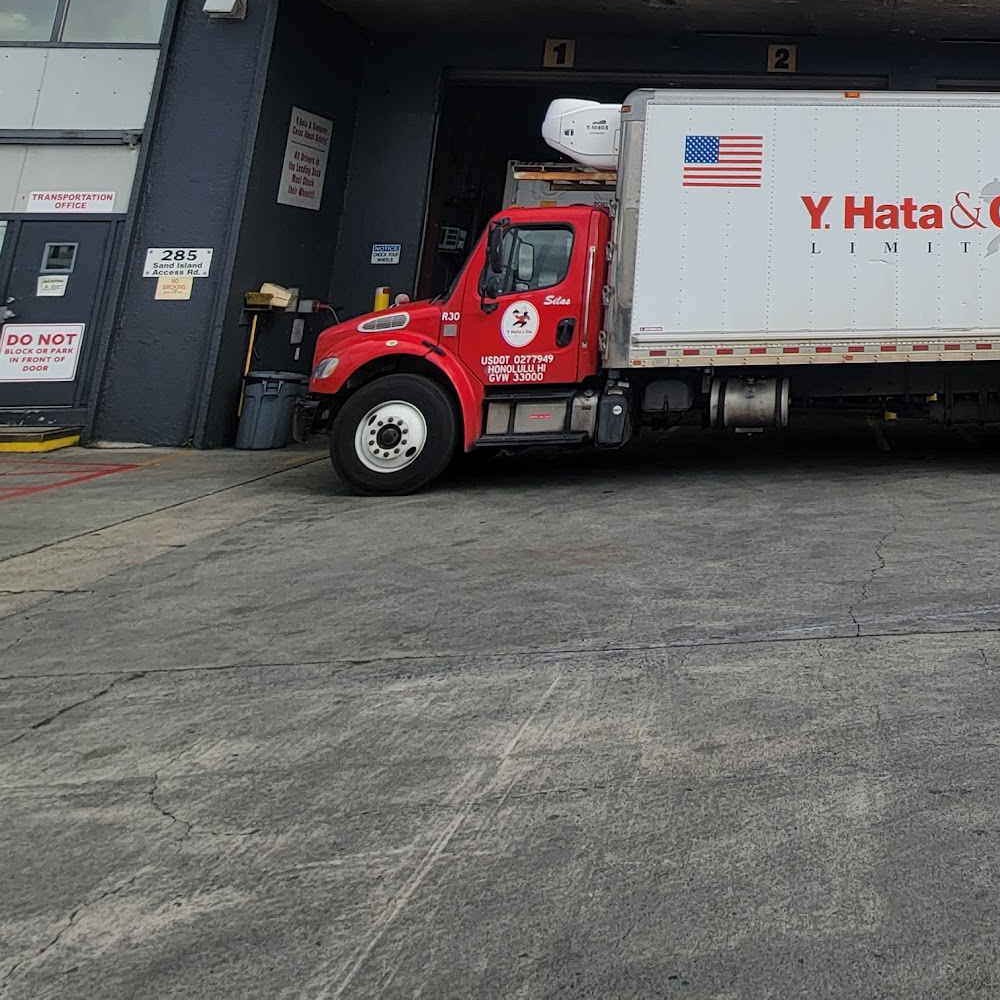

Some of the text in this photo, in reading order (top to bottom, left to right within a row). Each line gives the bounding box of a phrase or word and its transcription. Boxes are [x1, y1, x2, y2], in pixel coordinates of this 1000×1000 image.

[553, 43, 567, 64] 1
[774, 48, 790, 69] 2
[32, 193, 113, 201] TRANSPORTATION
[800, 195, 833, 229] Y.
[843, 195, 943, 229] Hata
[950, 191, 988, 229] &
[161, 249, 197, 261] 285
[543, 295, 571, 305] Silas
[442, 312, 460, 320] R30
[6, 333, 77, 346] DO NOT
[481, 354, 554, 365] USDOT 0277949
[537, 364, 547, 373] HI
[489, 373, 543, 382] GVW 33000
